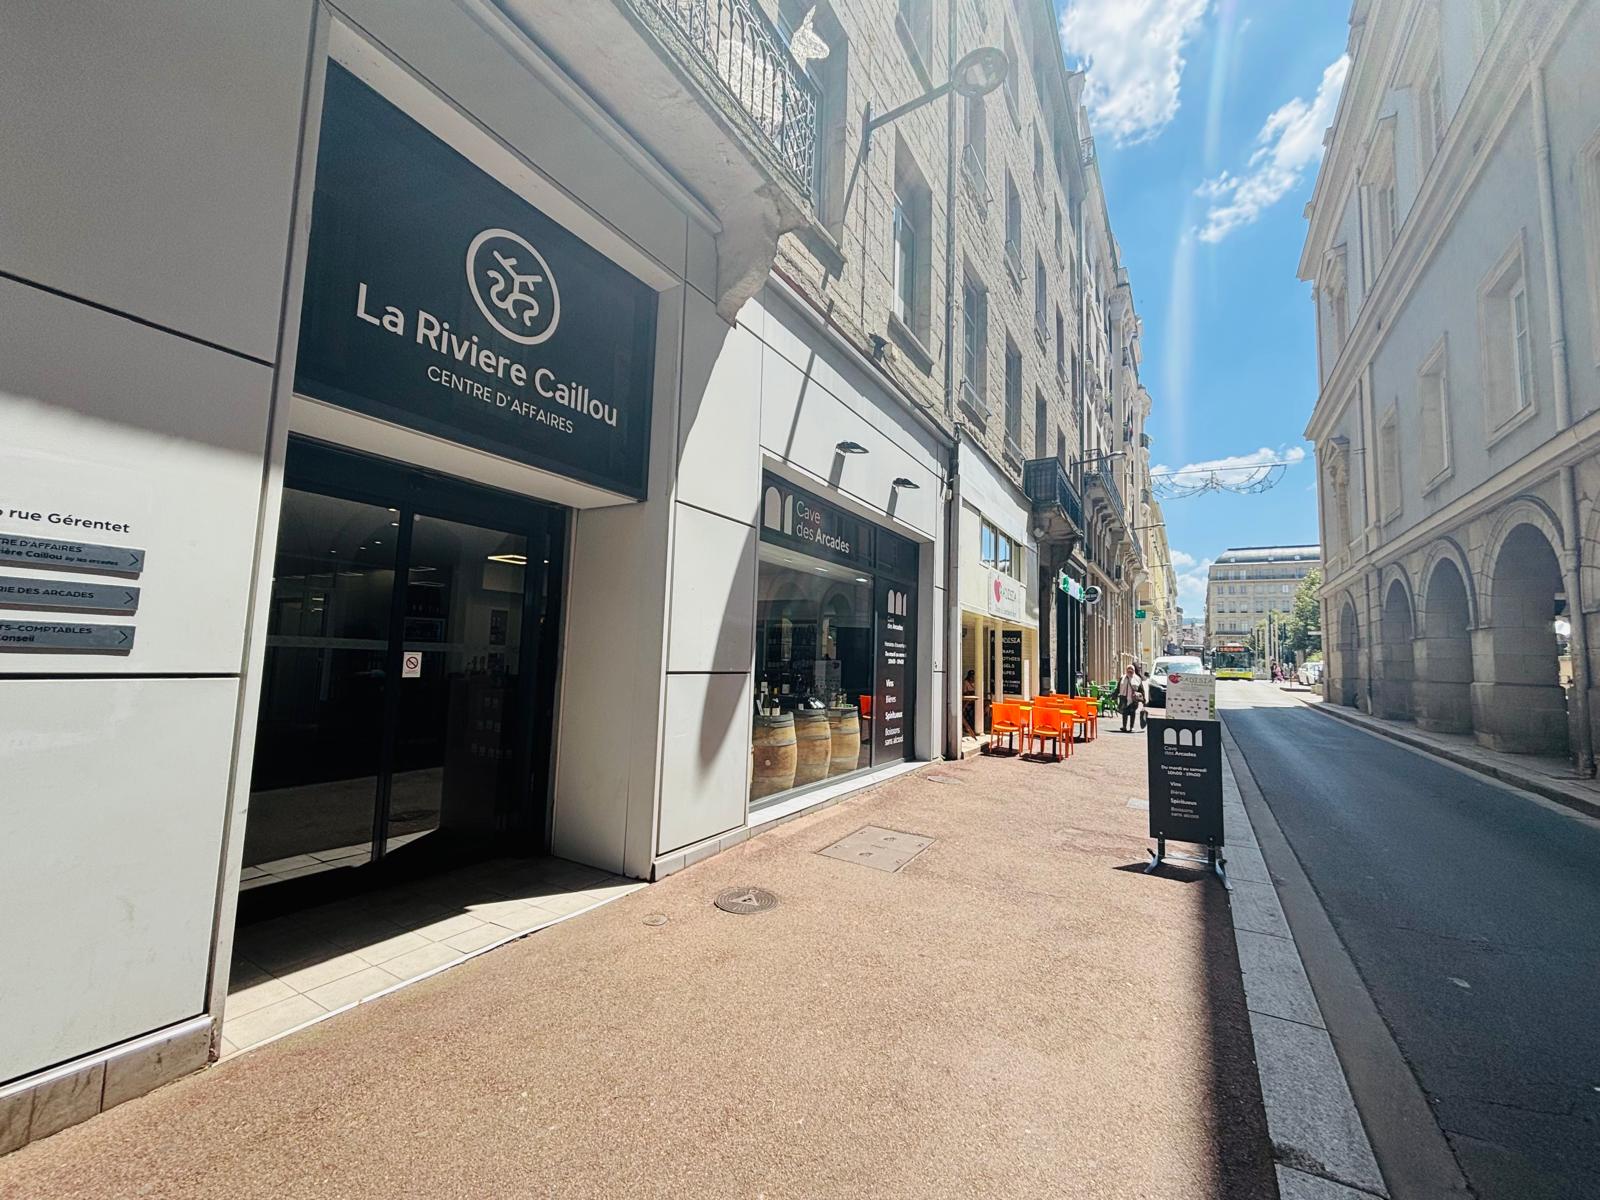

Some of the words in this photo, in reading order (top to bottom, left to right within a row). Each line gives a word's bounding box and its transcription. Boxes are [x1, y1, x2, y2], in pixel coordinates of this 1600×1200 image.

[356, 282, 405, 336] La
[416, 310, 527, 386] Riviere
[534, 368, 618, 427] Caillou
[427, 365, 491, 403] CENTRE
[496, 392, 574, 434] D'AFFAIRES
[9, 509, 42, 521] rue
[47, 513, 131, 533] Gérentet
[796, 500, 821, 524] Cave
[20, 540, 83, 553] D'AFFAIRES
[796, 522, 814, 541] des
[815, 528, 850, 554] Arcades
[25, 550, 63, 560] Caillou
[17, 587, 40, 595] DES
[42, 588, 95, 599] ARCADES
